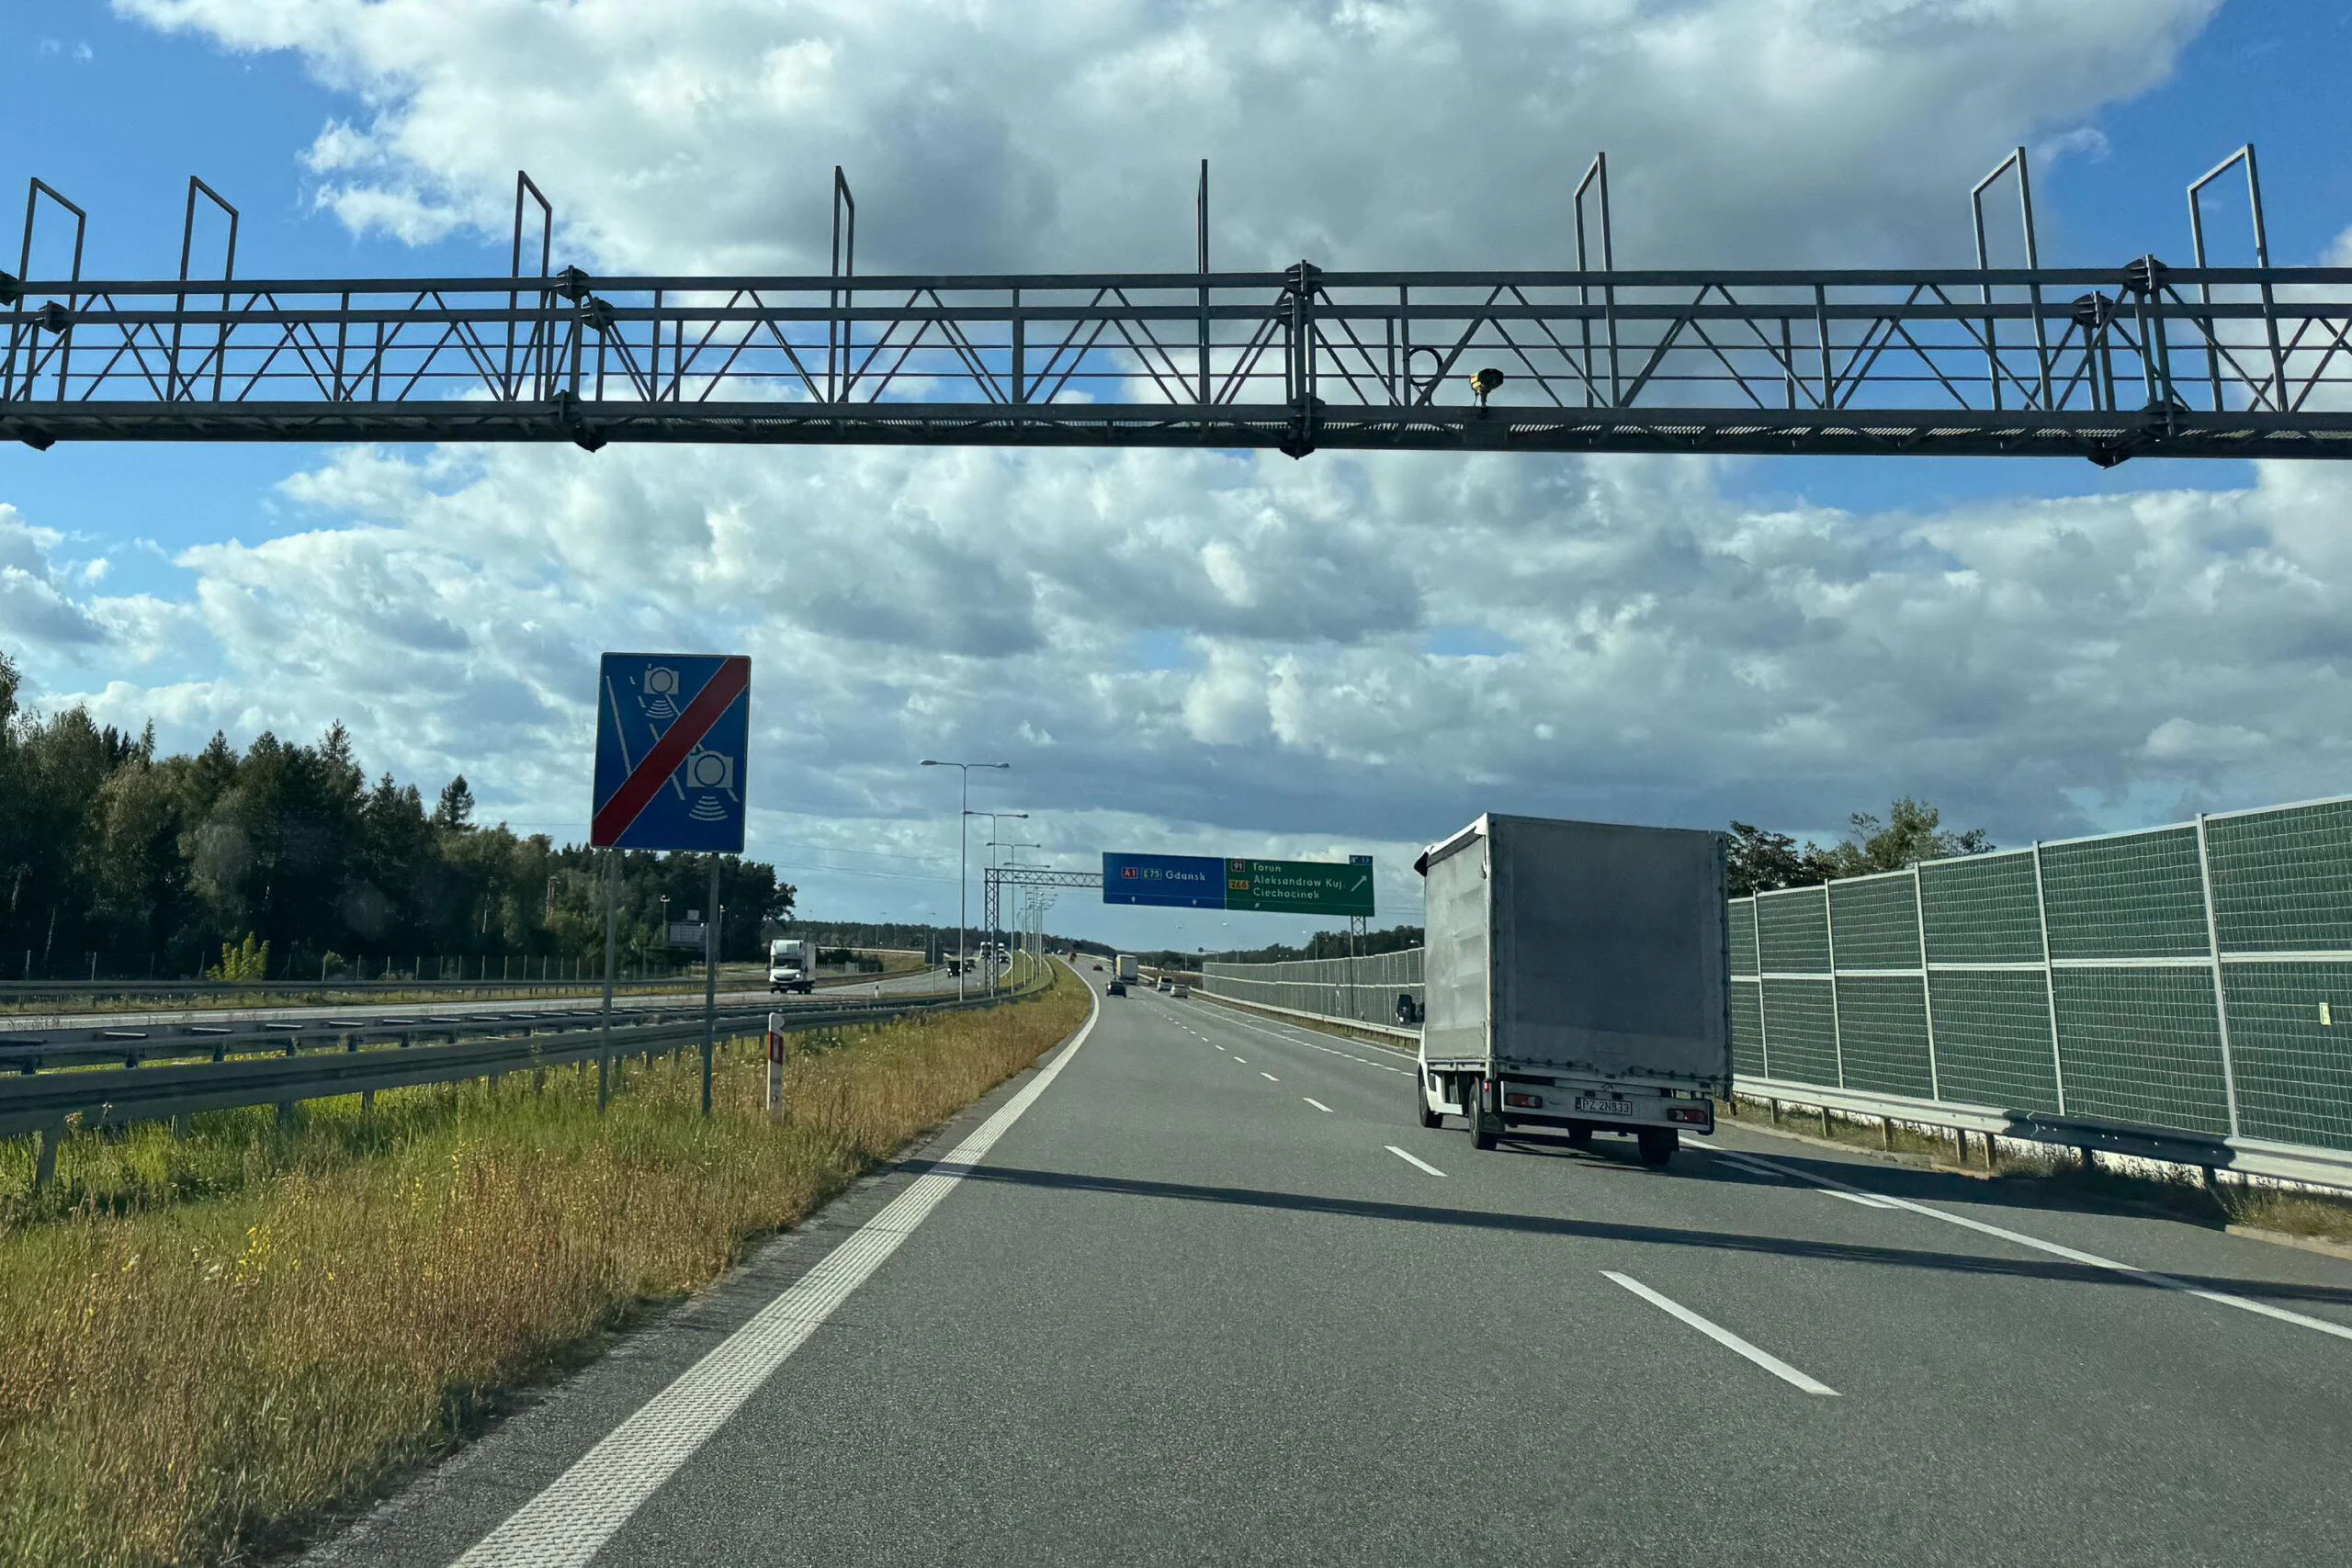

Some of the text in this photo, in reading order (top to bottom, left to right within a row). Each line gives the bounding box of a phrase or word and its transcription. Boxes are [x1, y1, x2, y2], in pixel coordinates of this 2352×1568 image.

[1233, 863, 1243, 871] 91
[1252, 887, 1319, 899] Ciechocinek
[1582, 1100, 1596, 1110] PZ
